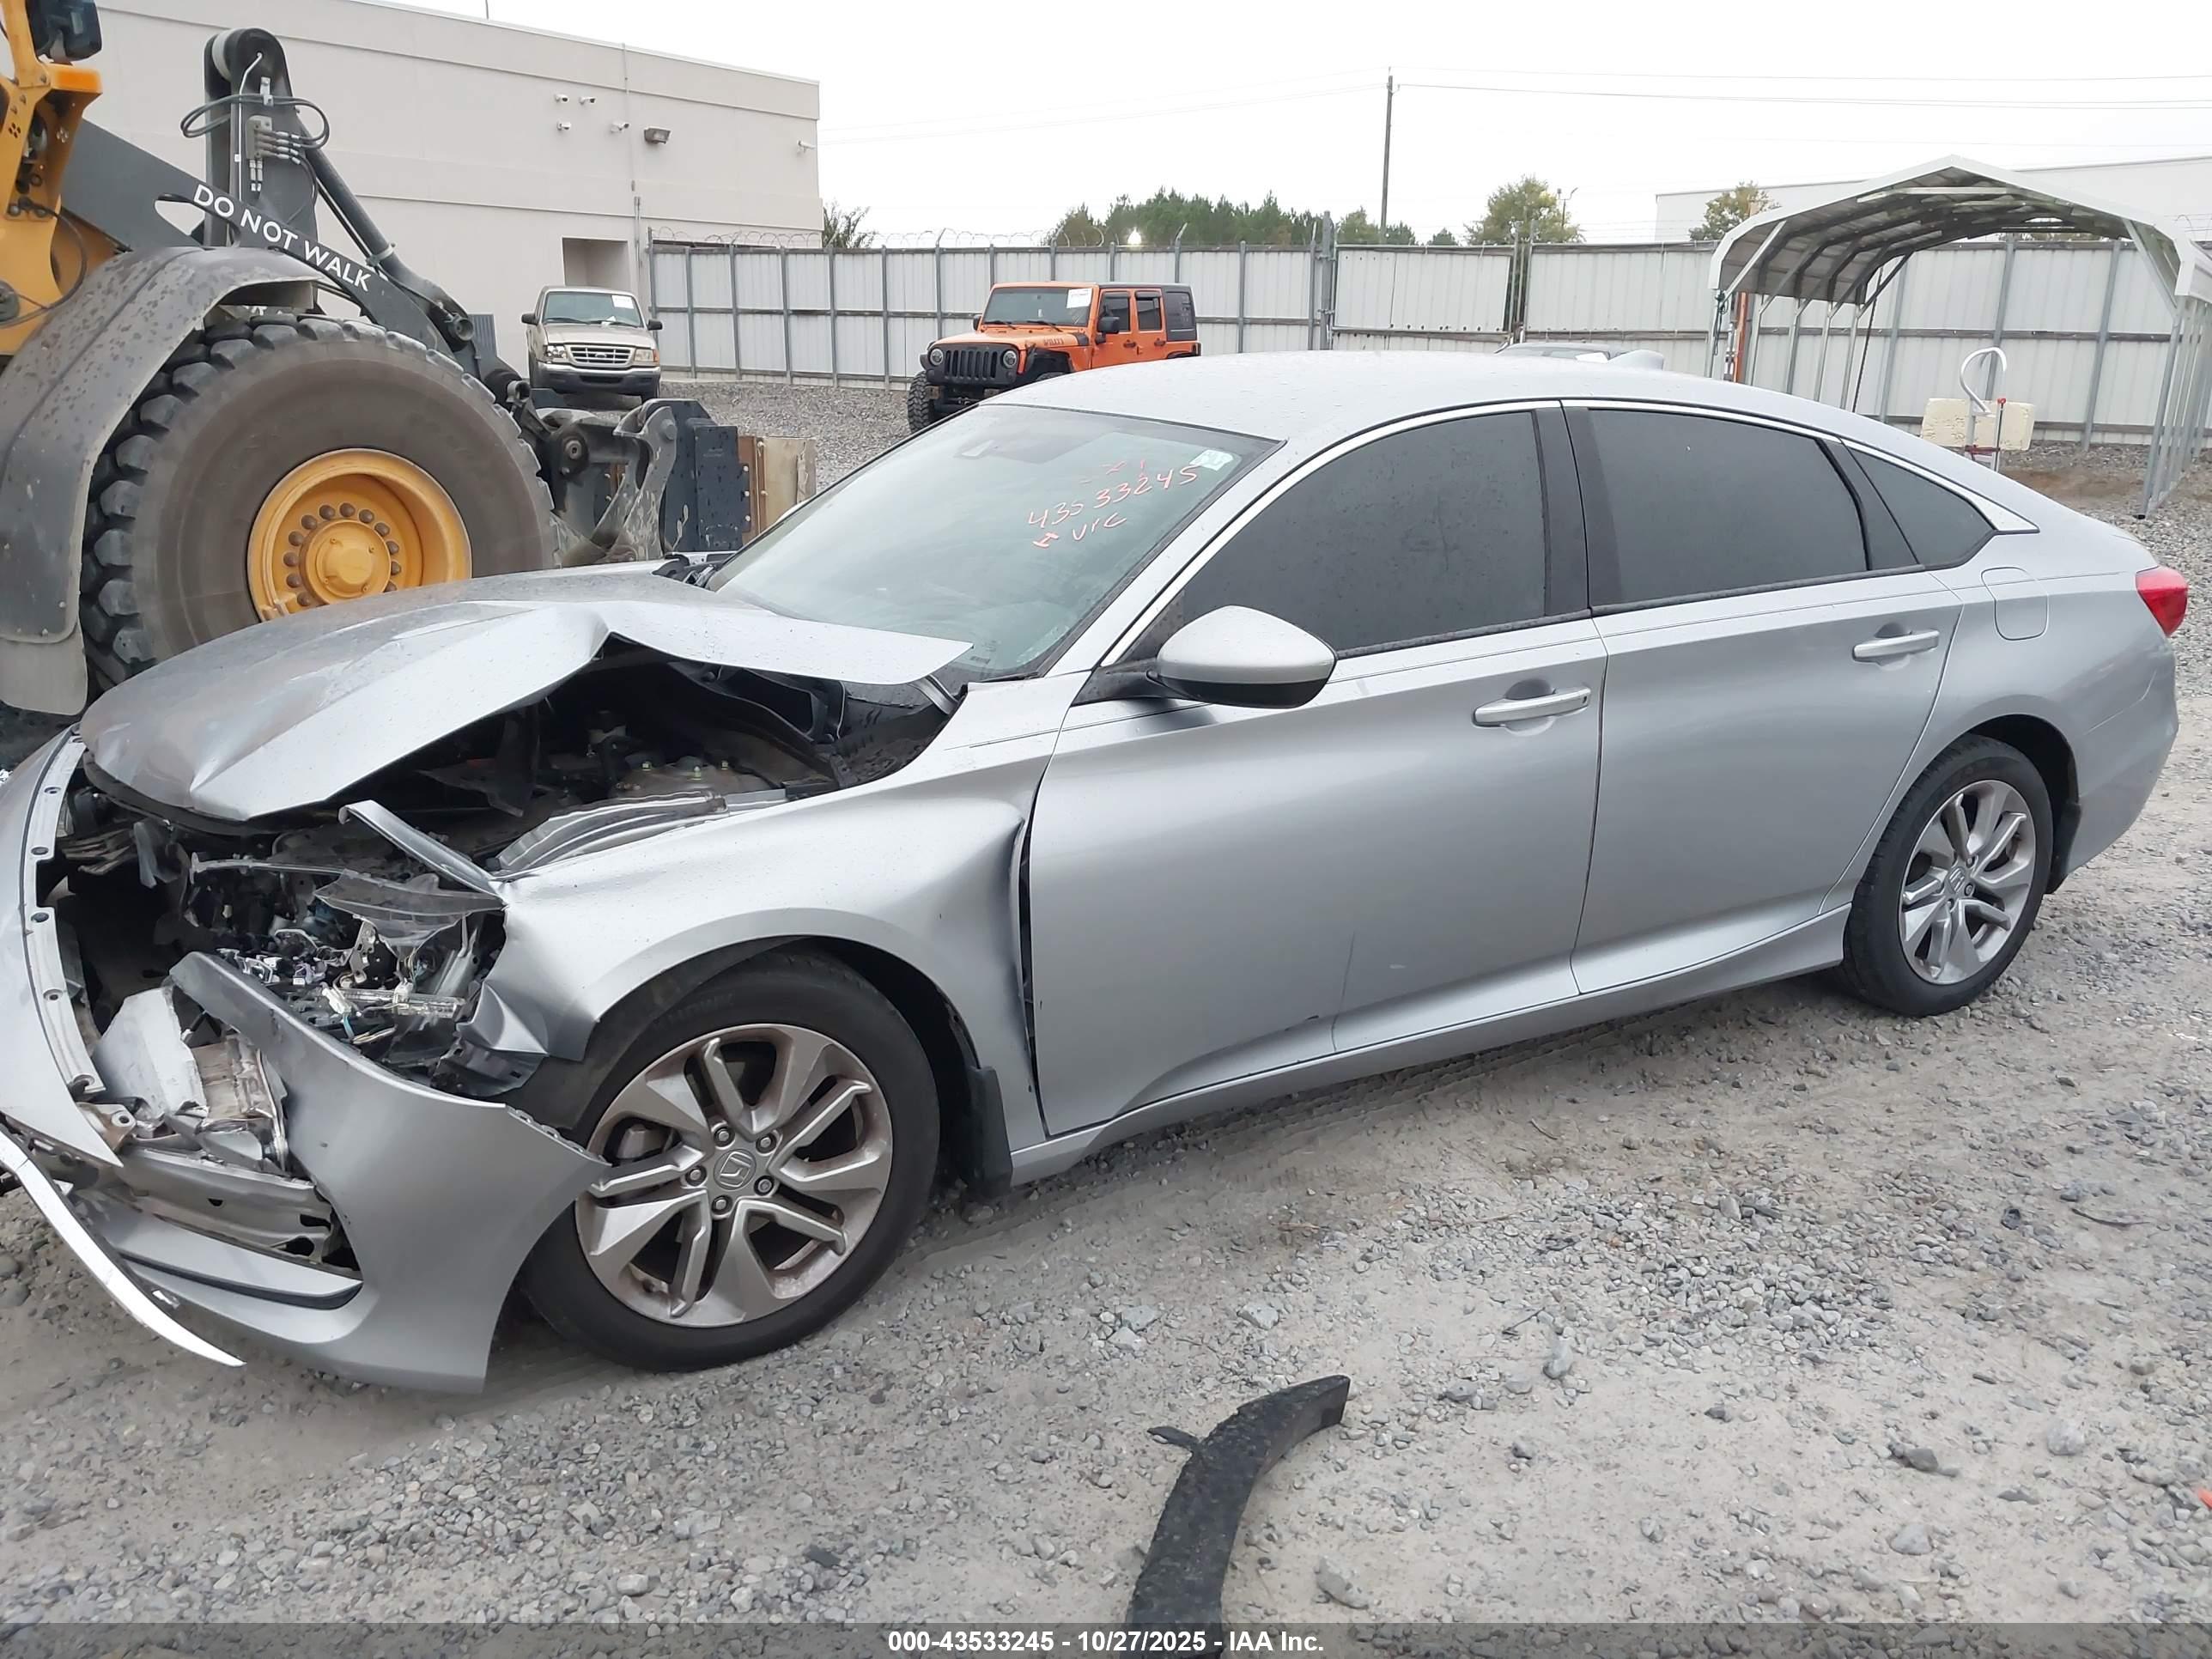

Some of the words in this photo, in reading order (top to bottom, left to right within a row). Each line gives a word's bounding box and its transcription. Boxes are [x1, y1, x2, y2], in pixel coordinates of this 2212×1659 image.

[193, 184, 234, 218] DO
[240, 209, 299, 250] NOT
[303, 240, 373, 292] WALK
